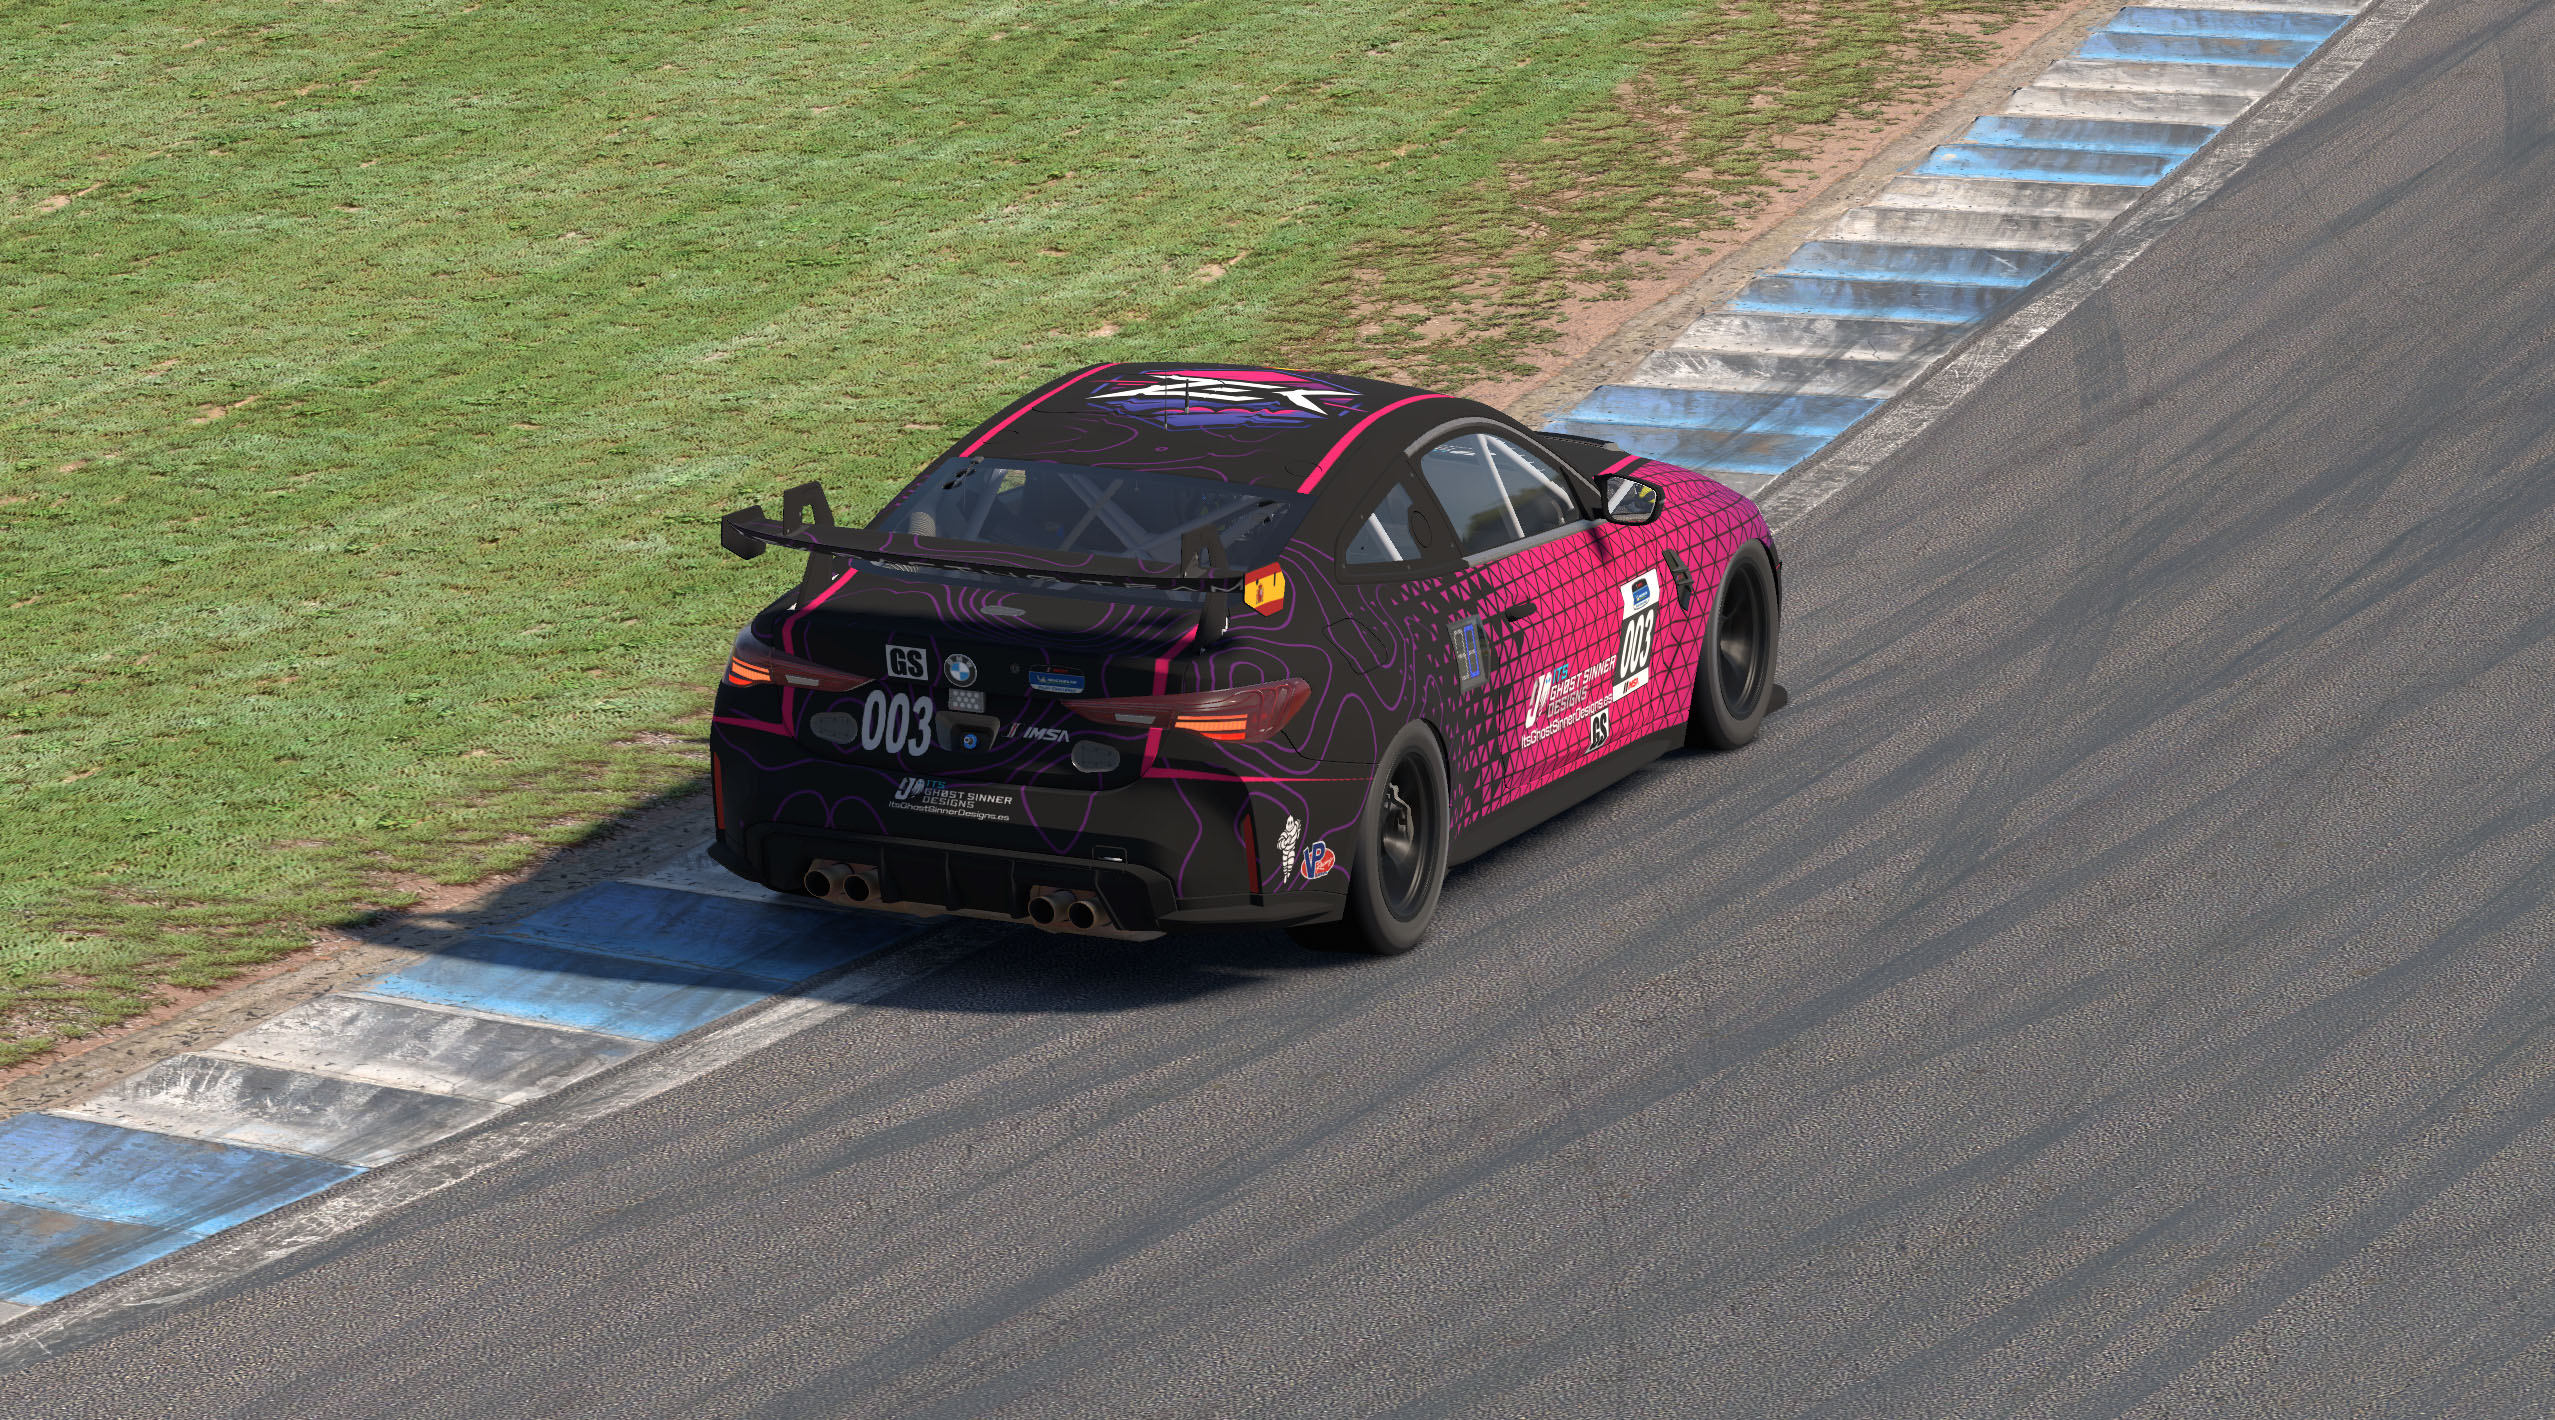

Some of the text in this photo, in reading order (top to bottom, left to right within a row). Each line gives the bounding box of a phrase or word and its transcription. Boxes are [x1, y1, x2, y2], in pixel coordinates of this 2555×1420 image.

[1620, 609, 1654, 678] 003
[889, 648, 924, 677] GS
[1552, 663, 1569, 684] ITS
[1583, 654, 1617, 684] SINNER
[1547, 685, 1588, 718] DESIGNS
[861, 689, 933, 756] 003
[1023, 726, 1070, 743] IMSA
[1521, 693, 1613, 749] ItsGhostSinnerDesigns.es
[1589, 712, 1608, 750] GS
[926, 779, 947, 789] ITS
[966, 792, 1013, 805] SINNER
[888, 801, 1010, 821] ItsGhostSinnerDesigns.es
[922, 796, 975, 809] DESIGNS
[1303, 841, 1327, 879] VP
